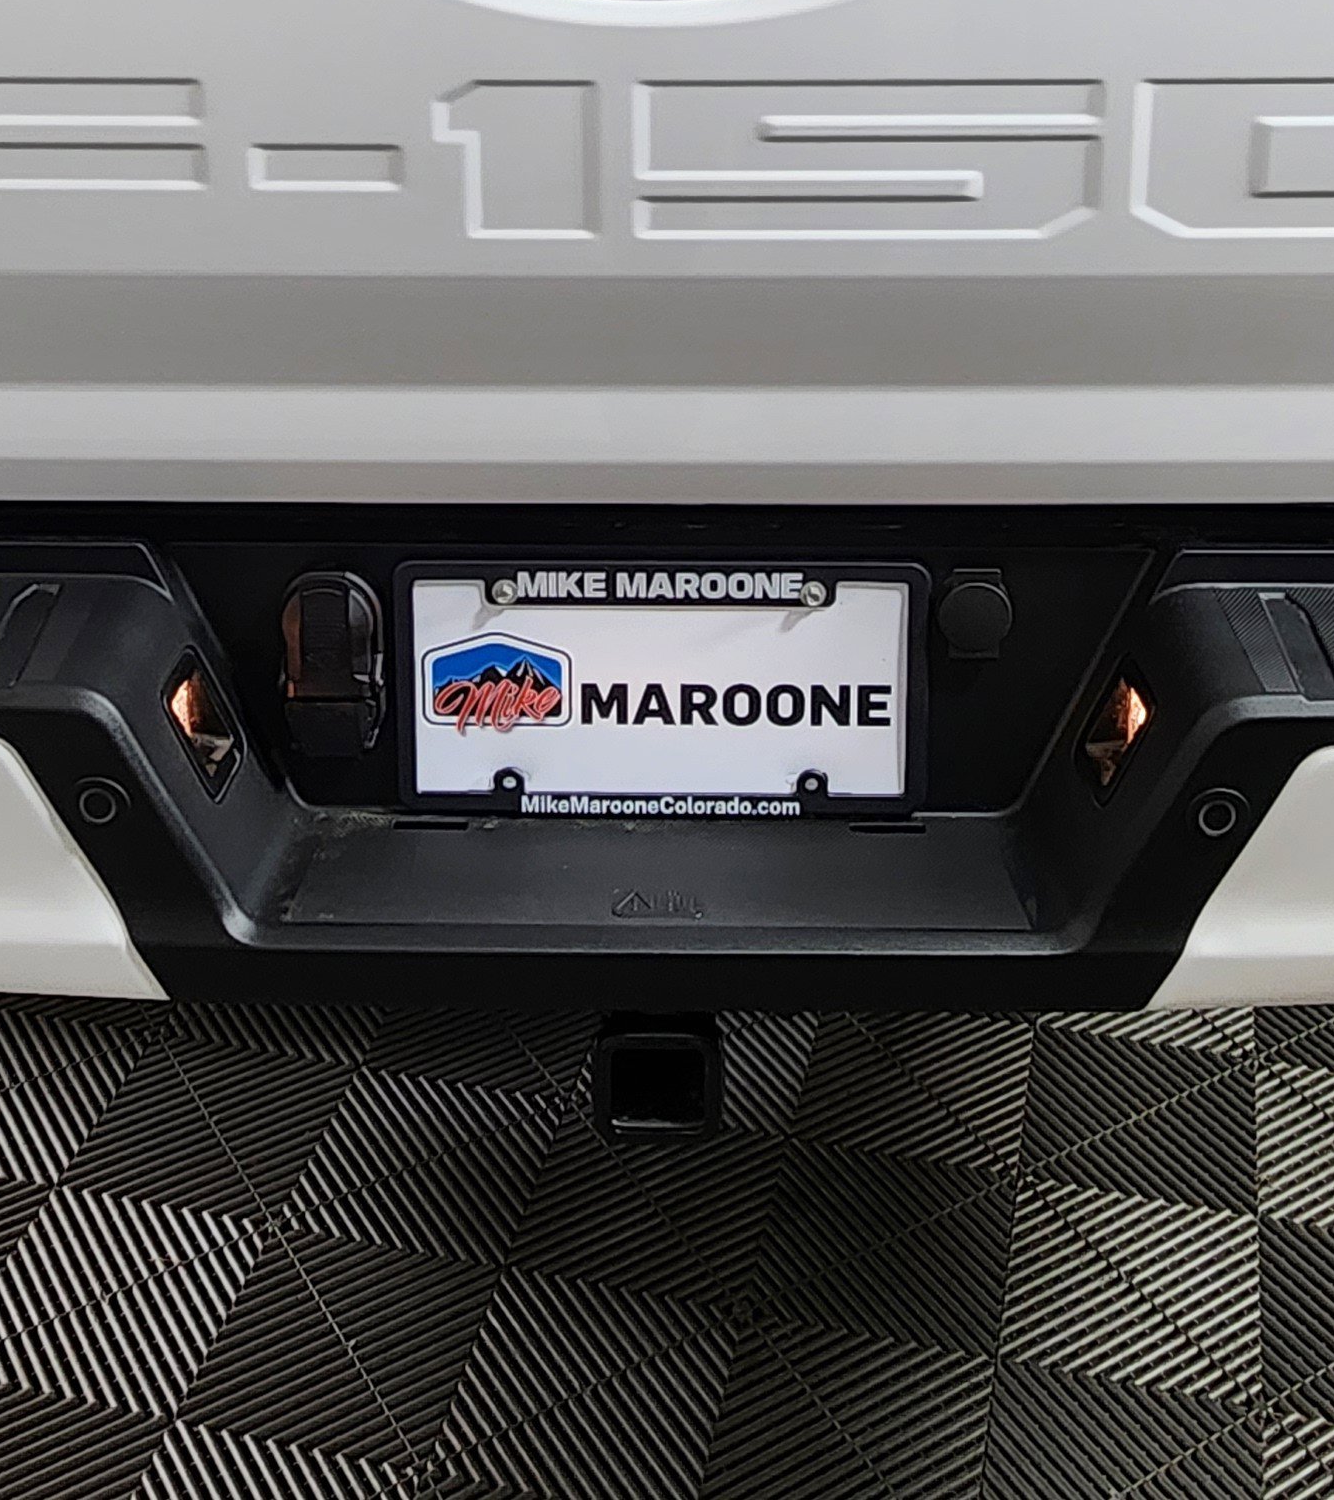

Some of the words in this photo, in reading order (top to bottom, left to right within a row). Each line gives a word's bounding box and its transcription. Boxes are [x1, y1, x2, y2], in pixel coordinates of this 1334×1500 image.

[516, 571, 607, 599] MIKE
[614, 571, 803, 601] MAROONE
[433, 678, 563, 735] Mike
[580, 683, 893, 727] MAROONE
[520, 796, 801, 818] MikeMarooneColorado.com
